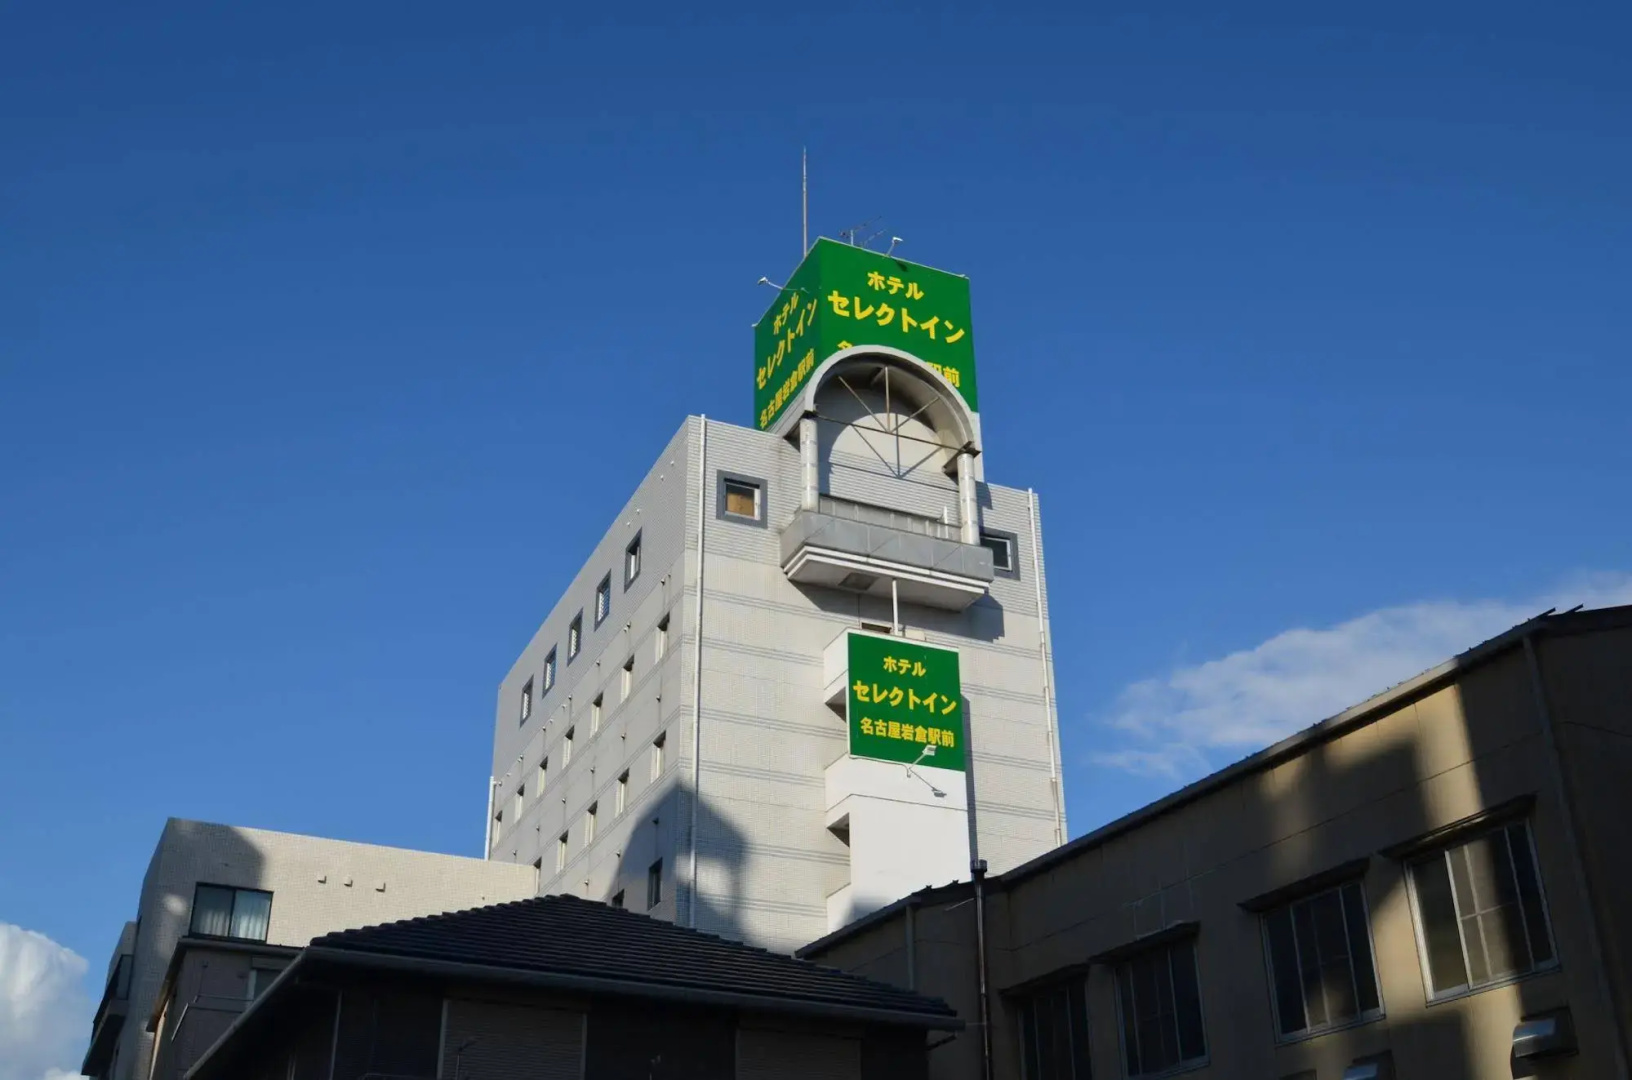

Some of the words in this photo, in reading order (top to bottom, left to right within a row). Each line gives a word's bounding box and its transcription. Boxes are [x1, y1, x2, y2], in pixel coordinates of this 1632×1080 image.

[867, 271, 925, 300] ホテル
[773, 292, 799, 335] ホテル
[827, 290, 965, 344] セレクトイン
[757, 298, 817, 390] セレクトイン
[760, 348, 815, 429] 名古屋岩倉駅前
[883, 656, 927, 677] ホテル
[852, 680, 957, 715] セレクトイン
[860, 717, 955, 748] 名古屋岩倉駅前
